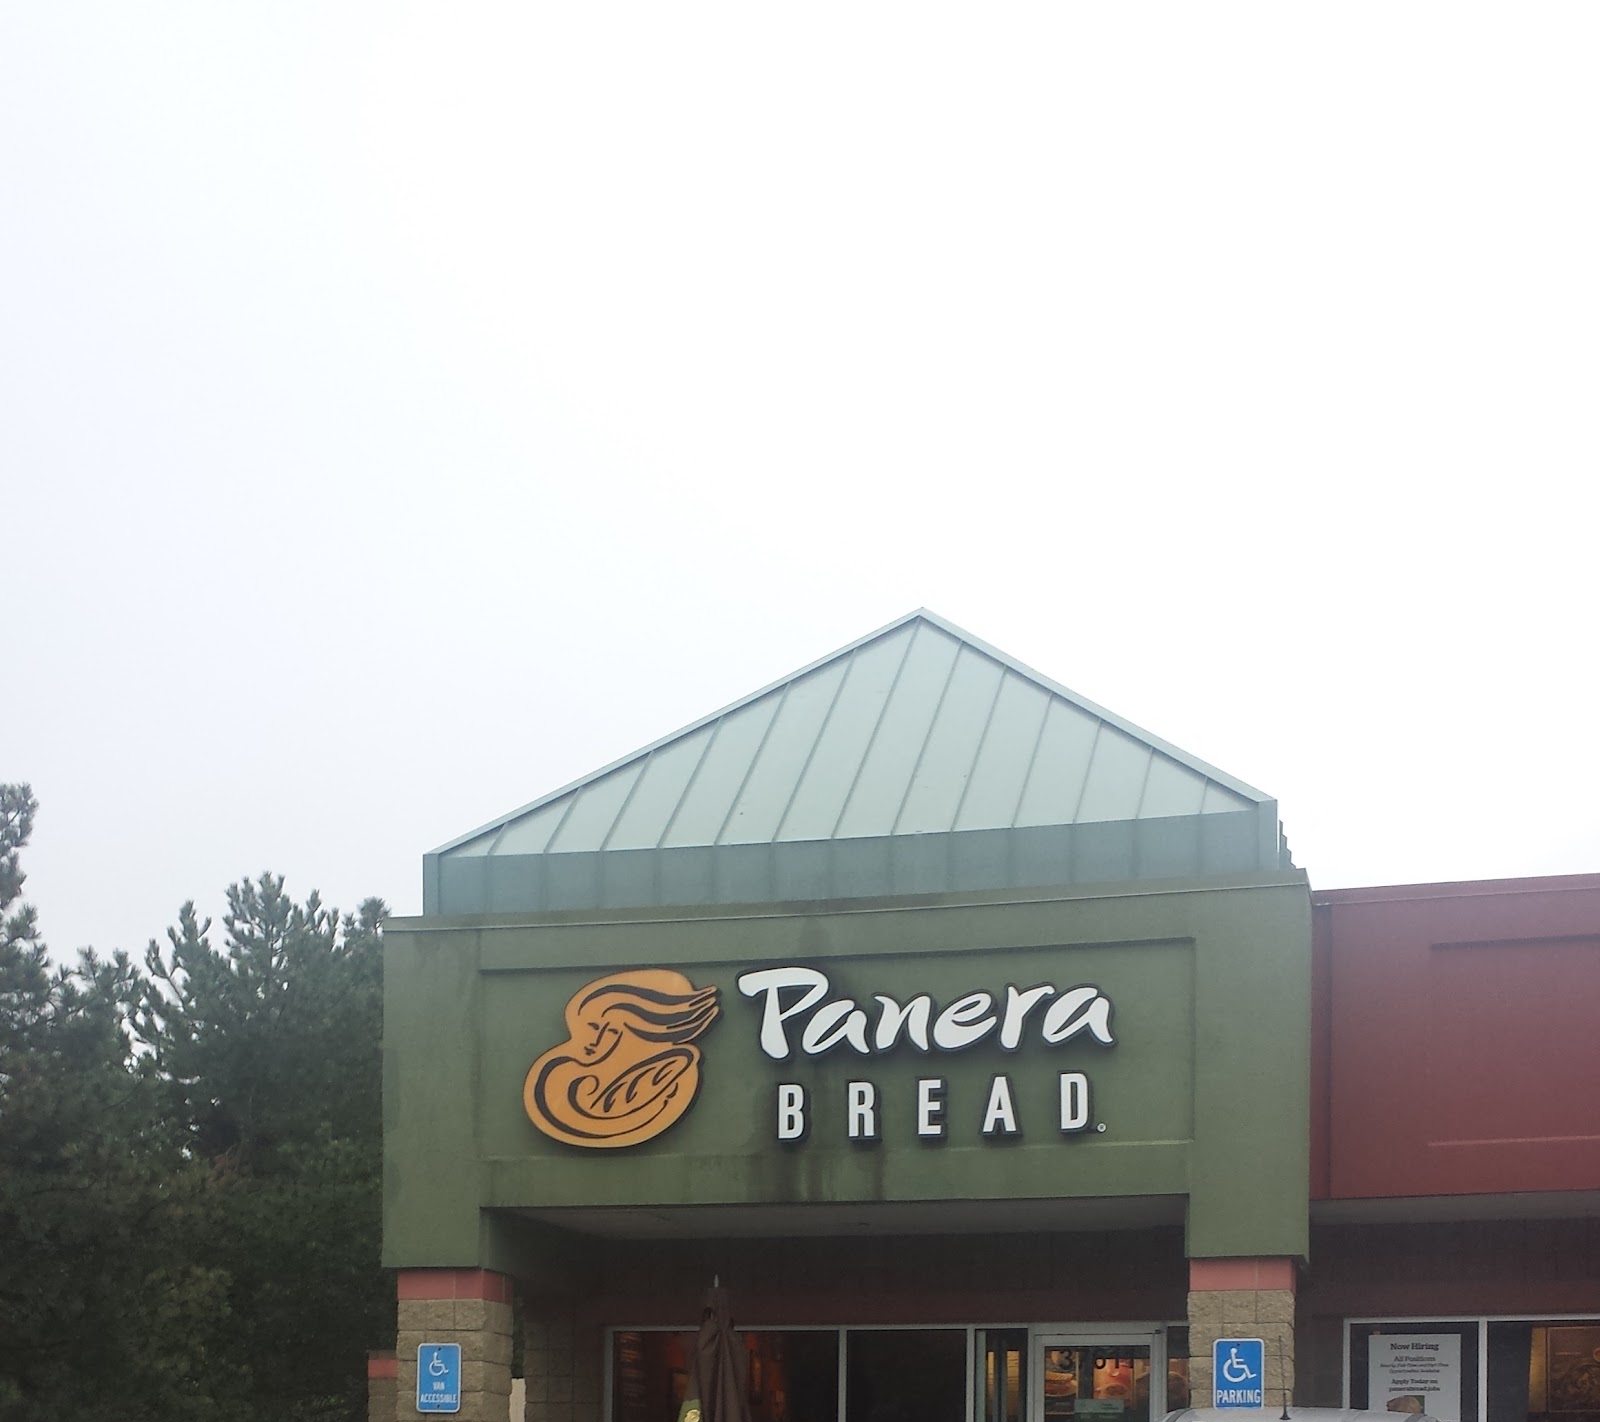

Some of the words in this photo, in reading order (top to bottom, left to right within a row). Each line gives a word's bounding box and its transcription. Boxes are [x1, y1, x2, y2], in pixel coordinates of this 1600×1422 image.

[737, 966, 1115, 1060] Panera
[777, 1073, 1090, 1139] BREAD
[1411, 1343, 1439, 1351] Hiring
[420, 1393, 458, 1404] ACCESSIBLE
[1216, 1389, 1262, 1404] PARKING
